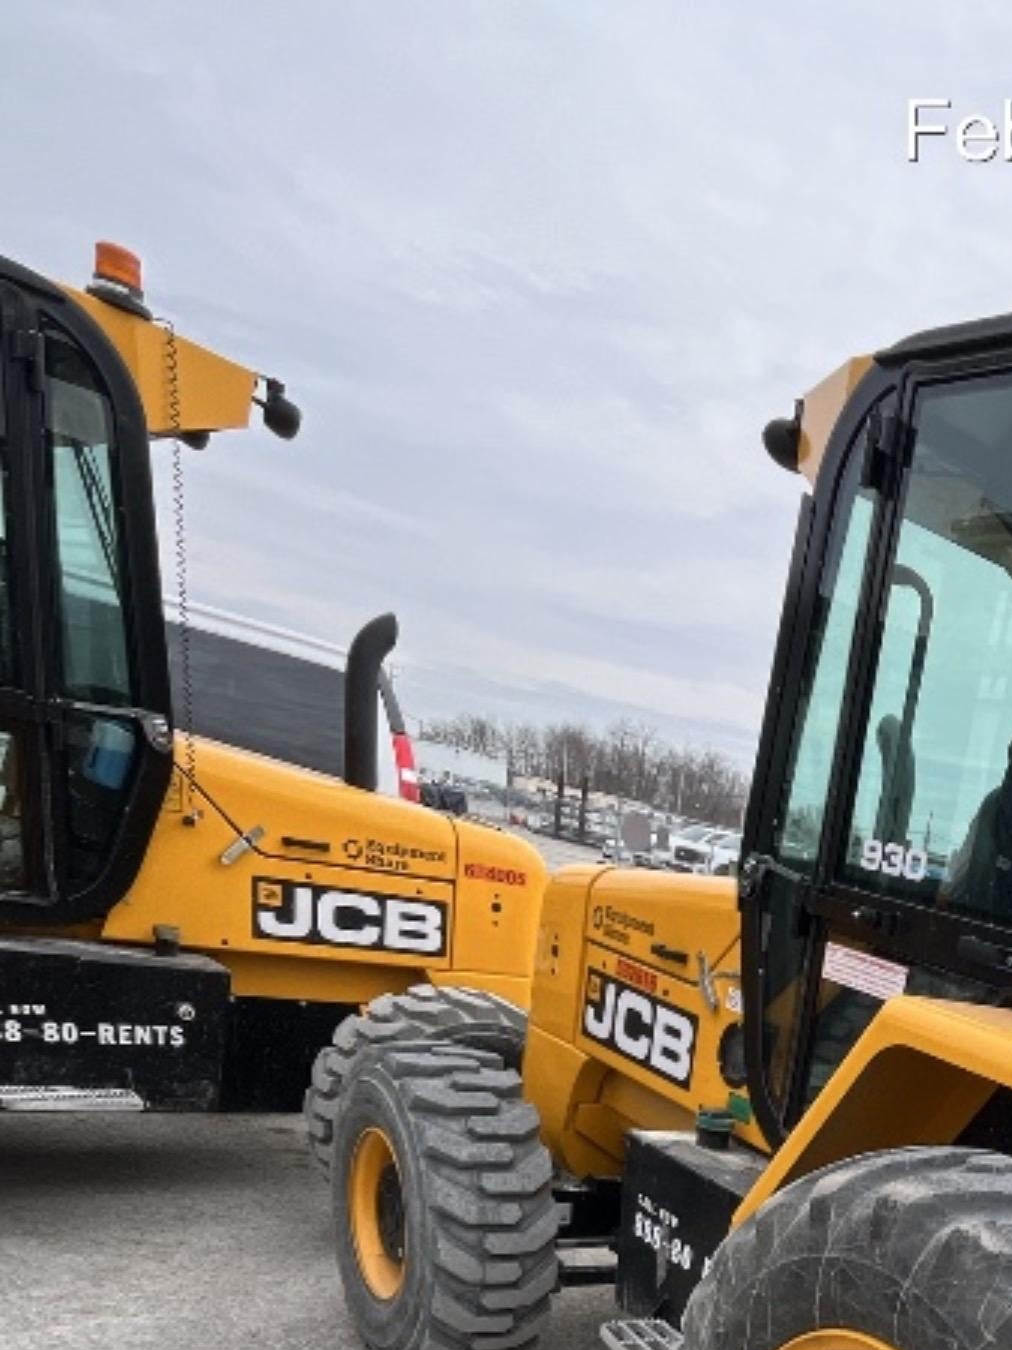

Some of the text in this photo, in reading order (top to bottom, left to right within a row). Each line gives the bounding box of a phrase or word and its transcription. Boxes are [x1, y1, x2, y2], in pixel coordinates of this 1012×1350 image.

[860, 839, 928, 881] 930
[257, 886, 443, 952] JCB
[584, 982, 694, 1082] JCB
